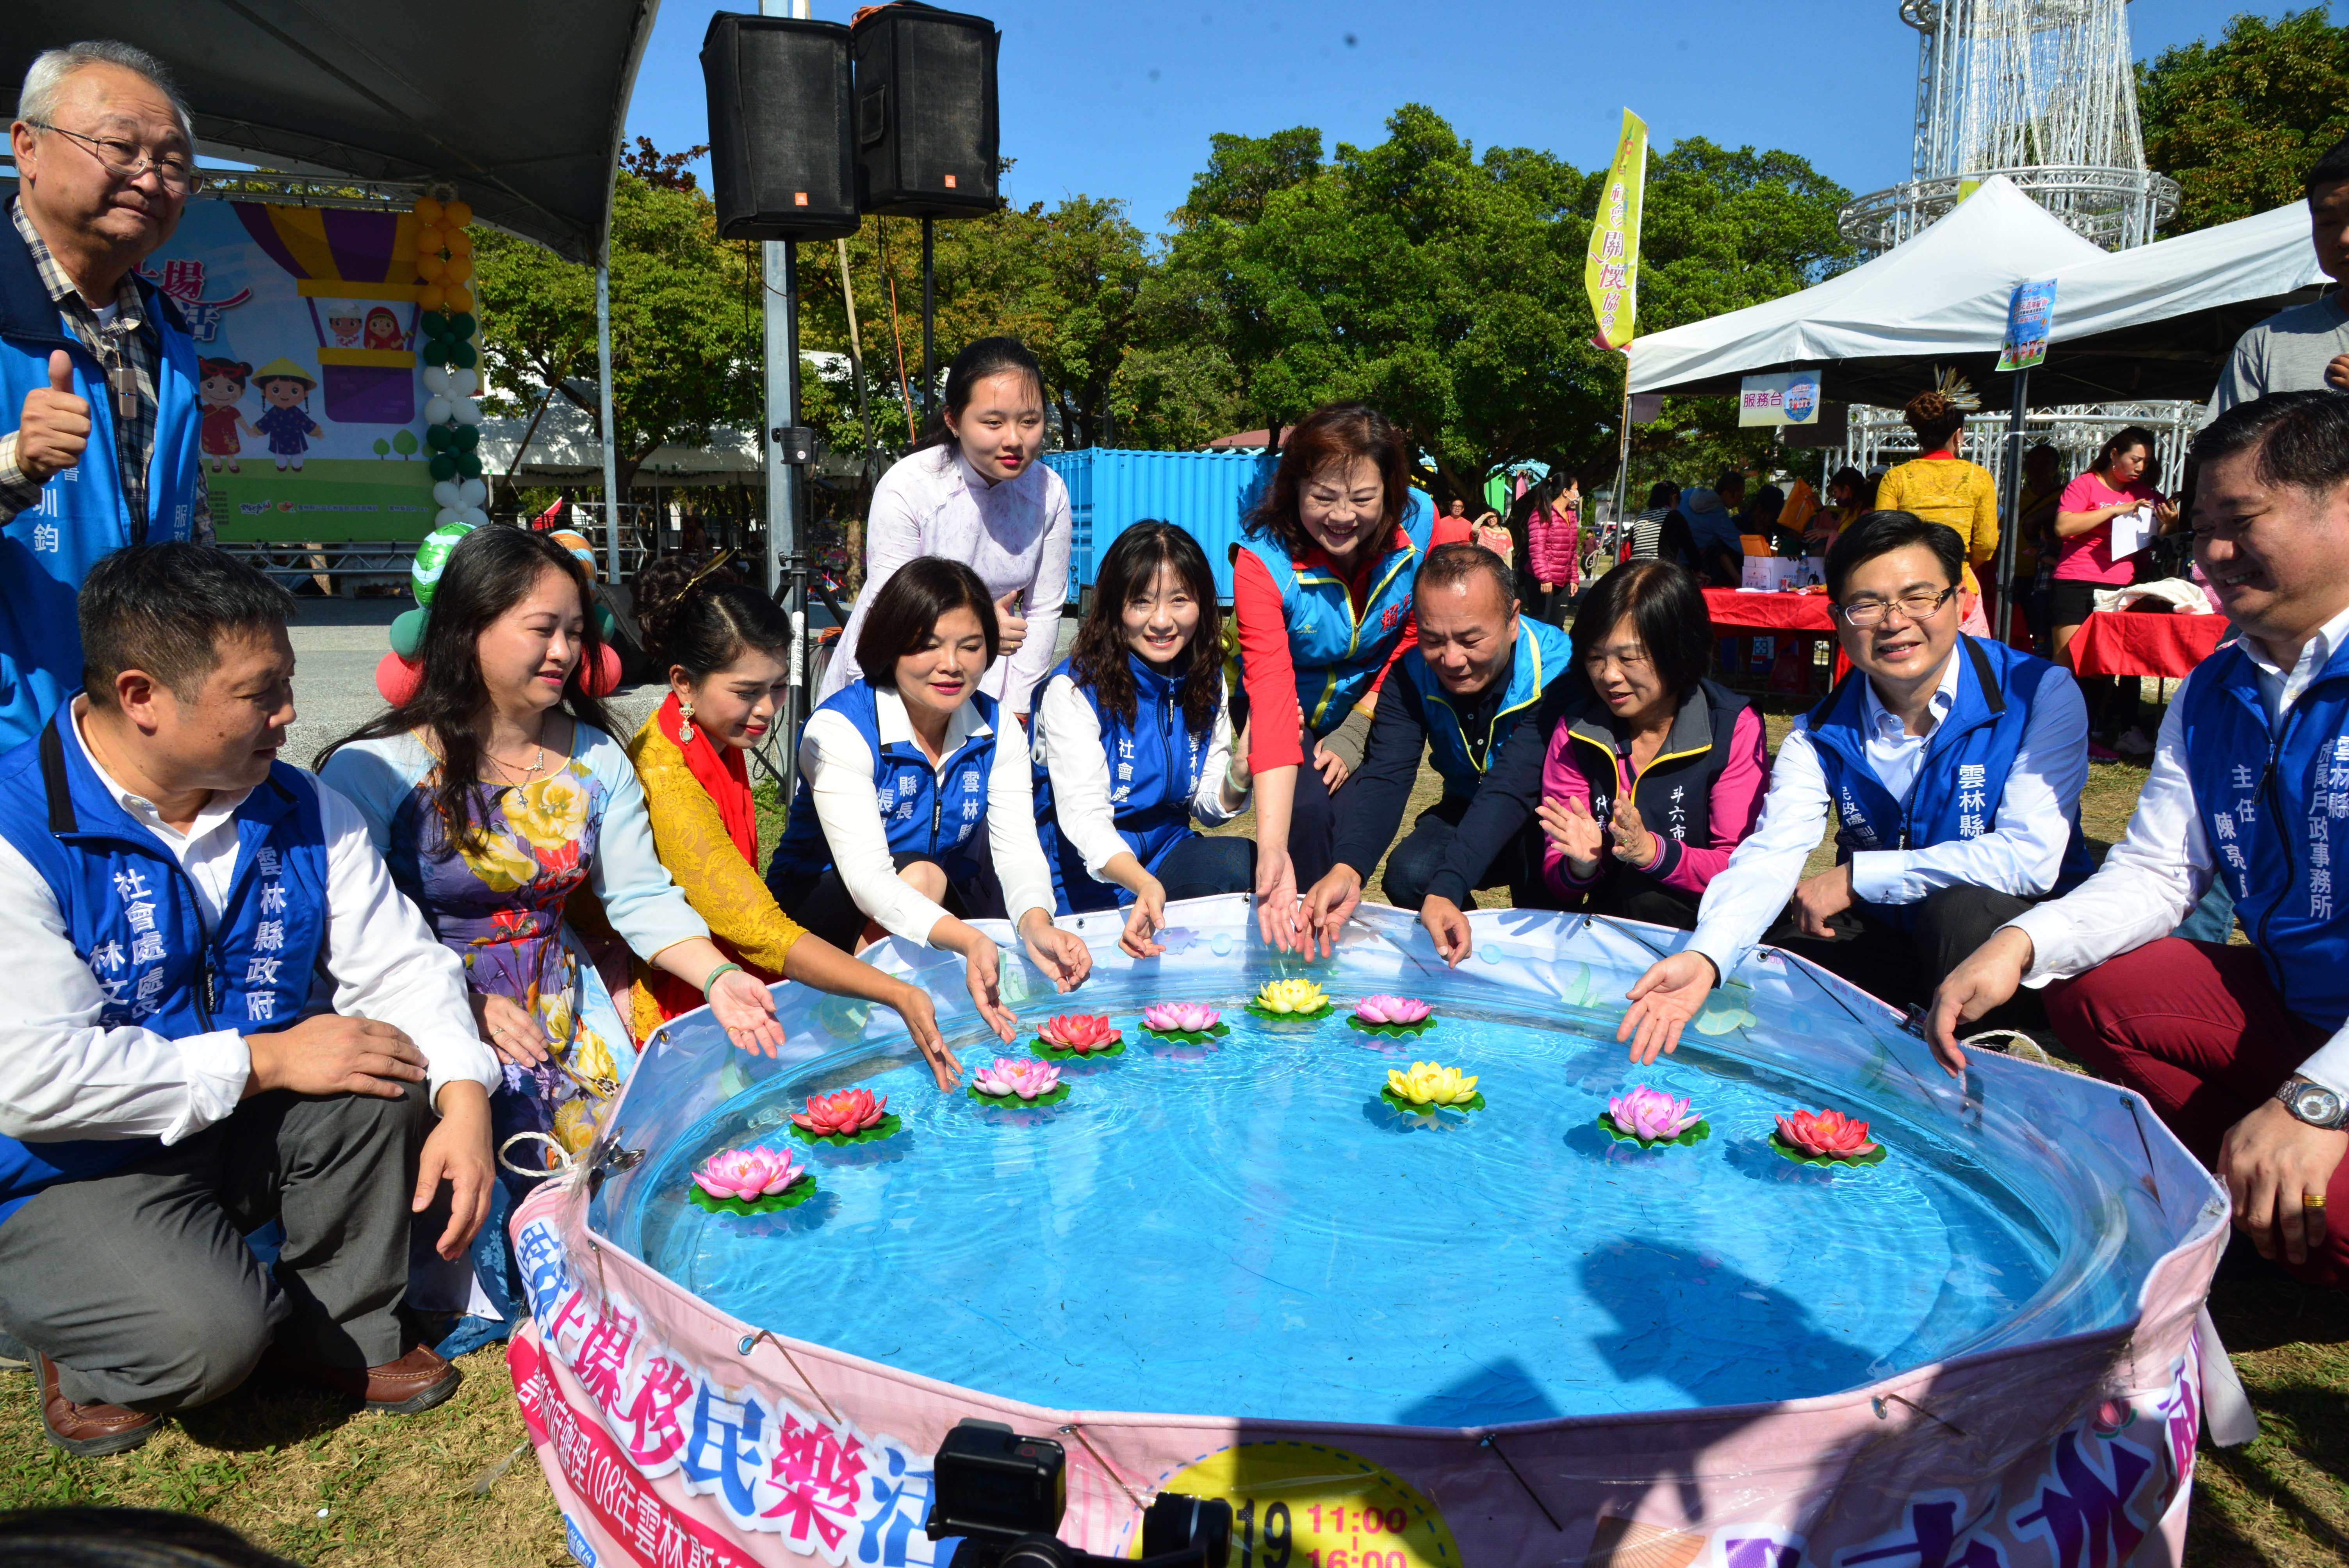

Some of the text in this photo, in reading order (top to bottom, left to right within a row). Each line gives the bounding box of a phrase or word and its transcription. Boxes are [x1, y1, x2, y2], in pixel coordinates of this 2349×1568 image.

[1743, 392, 1782, 408] 服務台
[896, 775, 917, 820] 縣長
[1110, 738, 1134, 803] 社會處
[2231, 763, 2255, 823] 主任
[957, 770, 980, 843] 雲林縣
[1668, 785, 1687, 841] 斗六市
[1958, 764, 1986, 843] 雲林縣
[2308, 738, 2335, 920] 虎尾戶政事務所
[113, 868, 167, 1019] 社會處處長
[245, 846, 287, 1021] 雲林縣政府
[1307, 1503, 1408, 1534] 11:00
